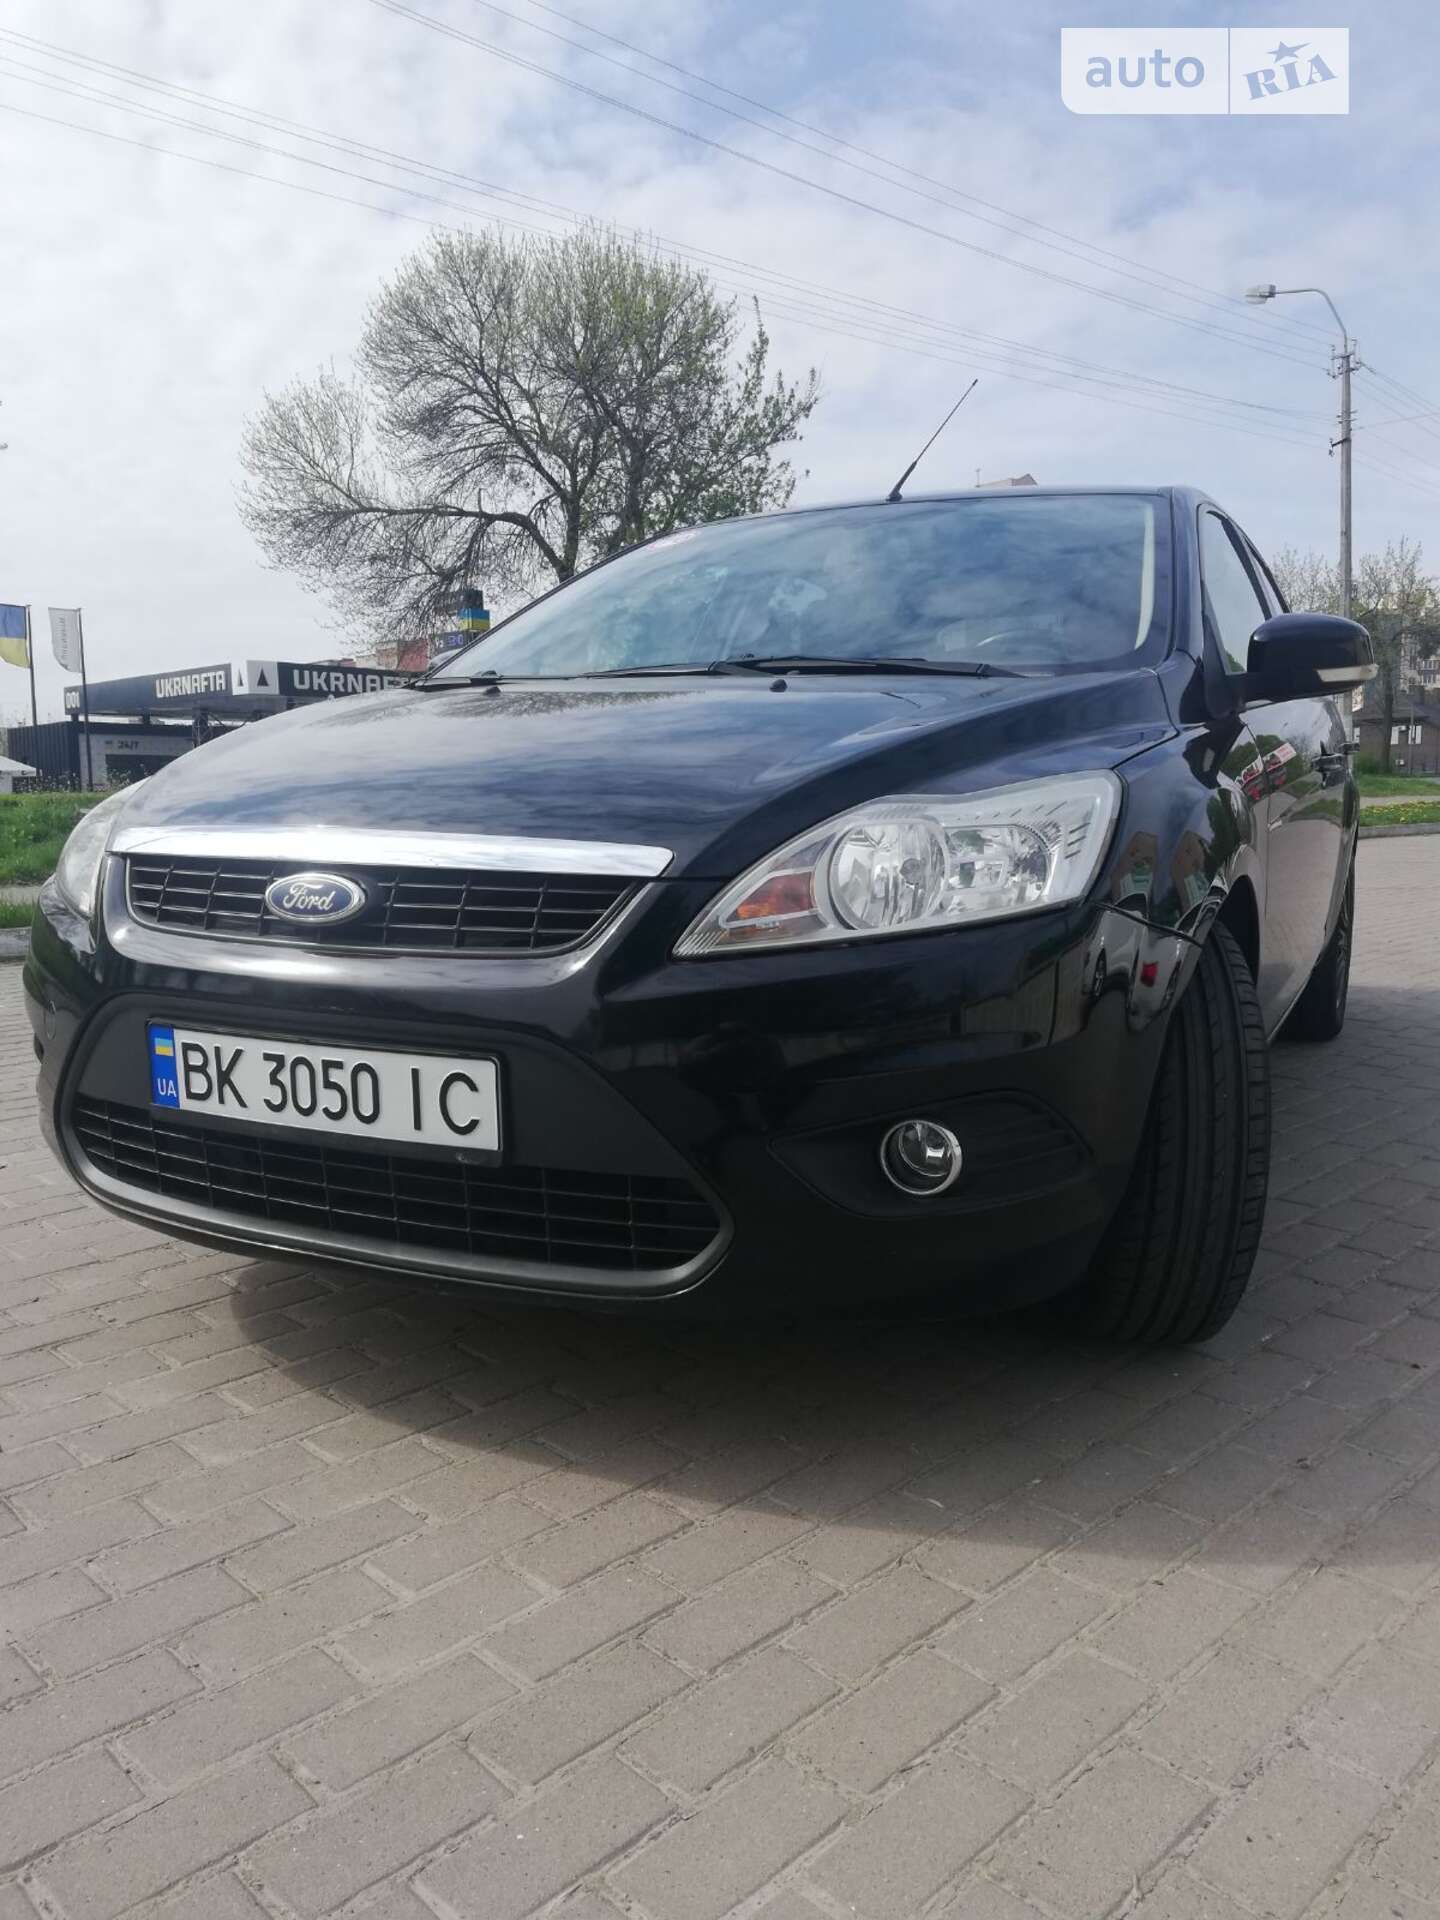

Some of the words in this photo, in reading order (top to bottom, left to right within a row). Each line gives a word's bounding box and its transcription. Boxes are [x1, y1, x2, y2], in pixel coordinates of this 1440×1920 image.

[155, 670, 226, 698] UKRNAFTA
[293, 669, 409, 693] UKRNAF
[282, 881, 337, 911] Ford
[157, 1078, 177, 1097] UA
[181, 1041, 248, 1109] BK
[262, 1052, 381, 1125] 3050
[411, 1067, 480, 1136] IC
